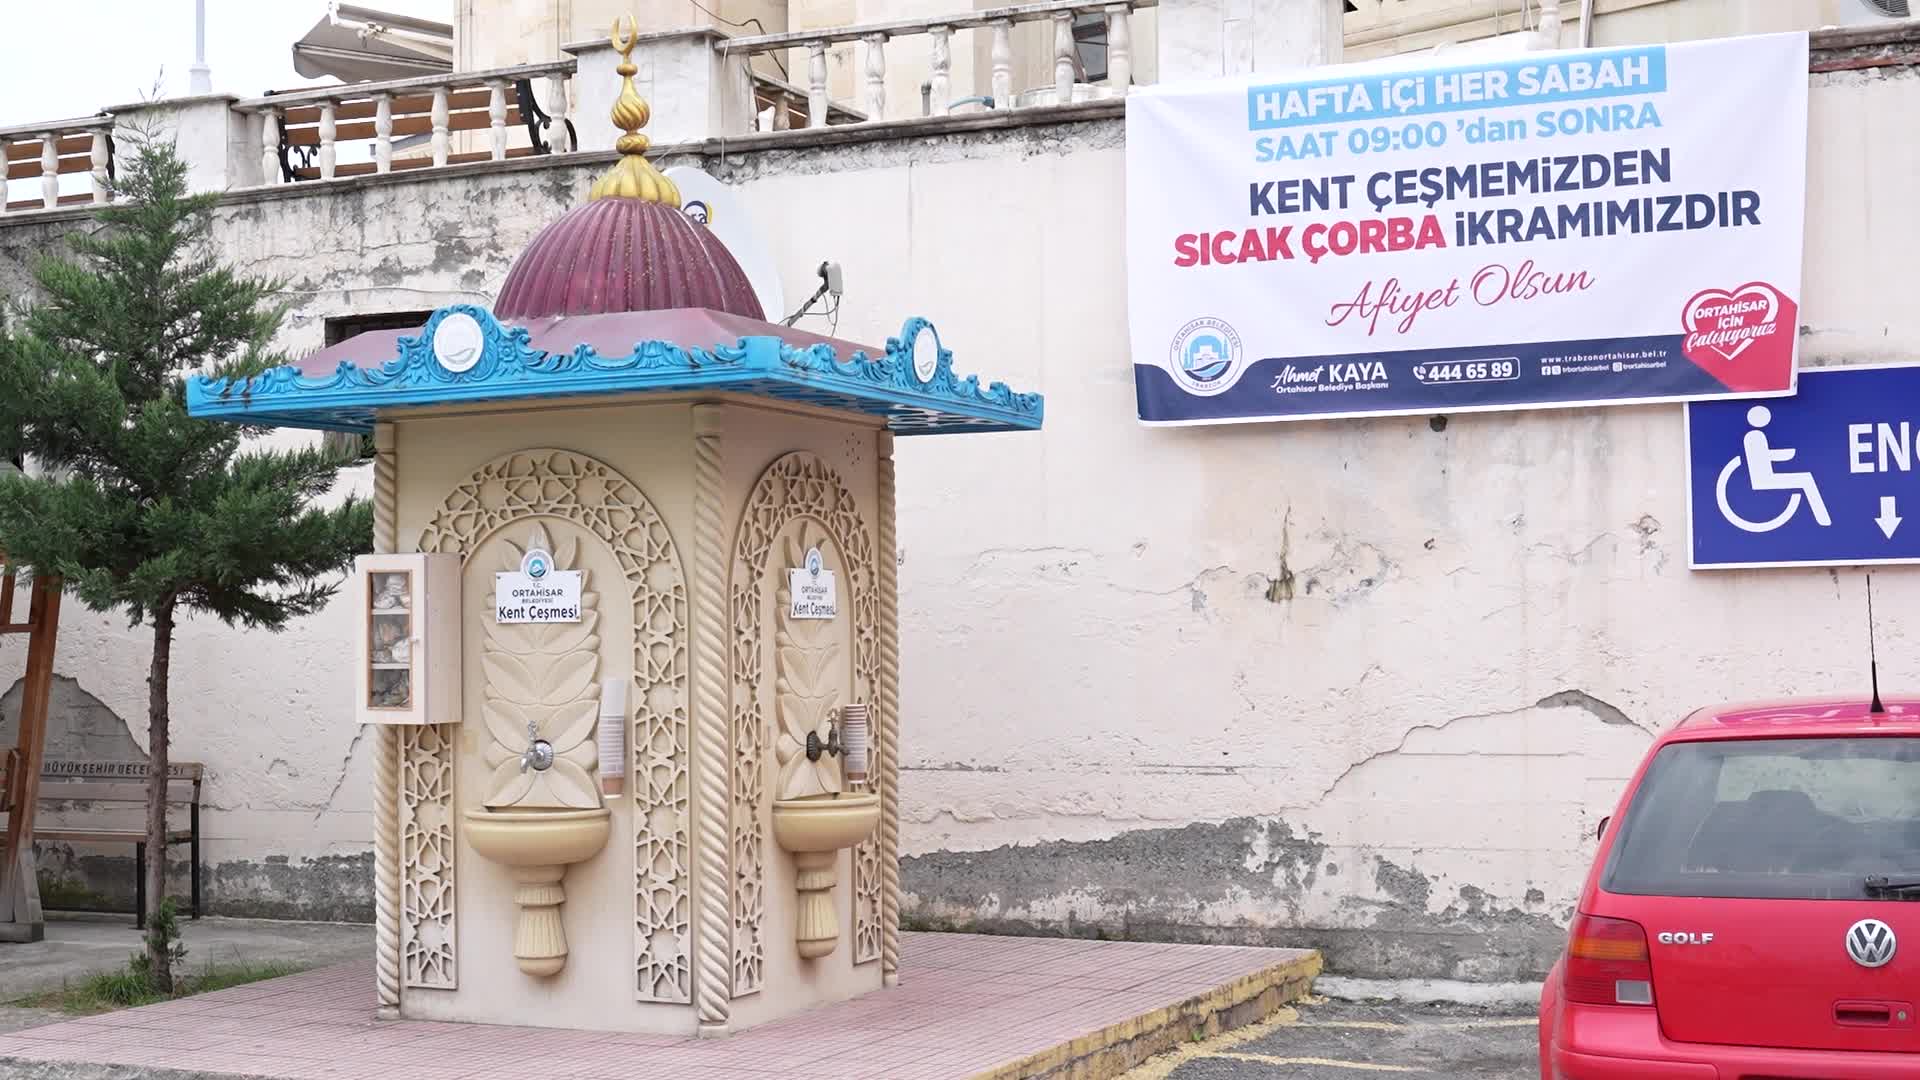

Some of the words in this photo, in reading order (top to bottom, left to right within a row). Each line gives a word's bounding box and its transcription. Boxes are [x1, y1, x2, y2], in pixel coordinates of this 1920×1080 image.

[1256, 83, 1373, 121] HAFTA
[1435, 70, 1508, 105] HER
[1517, 55, 1649, 96] SABAH
[1255, 130, 1339, 163] SAAT
[1348, 120, 1447, 155] 09:00
[1535, 101, 1663, 139] SONRA
[1250, 175, 1355, 216] KENT
[1174, 225, 1295, 267] SICAK
[1302, 214, 1448, 264] ÇORBA
[1325, 277, 1460, 336] Afiyet
[1470, 259, 1596, 306] Olsun
[1428, 364, 1462, 381] 444
[1466, 363, 1488, 379] 65
[1491, 361, 1513, 378] 89
[1541, 350, 1667, 364] www.trabzonortahisar.bel.tr
[1270, 364, 1325, 389] Ahmet
[1329, 361, 1389, 383] KAYA
[1276, 385, 1317, 394] Ortahisar
[1318, 382, 1354, 392] Belediye
[1848, 422, 1920, 473] EN
[498, 606, 525, 619] Kent
[528, 604, 578, 621] Çeşmesi
[1657, 932, 1714, 945] GOLF
